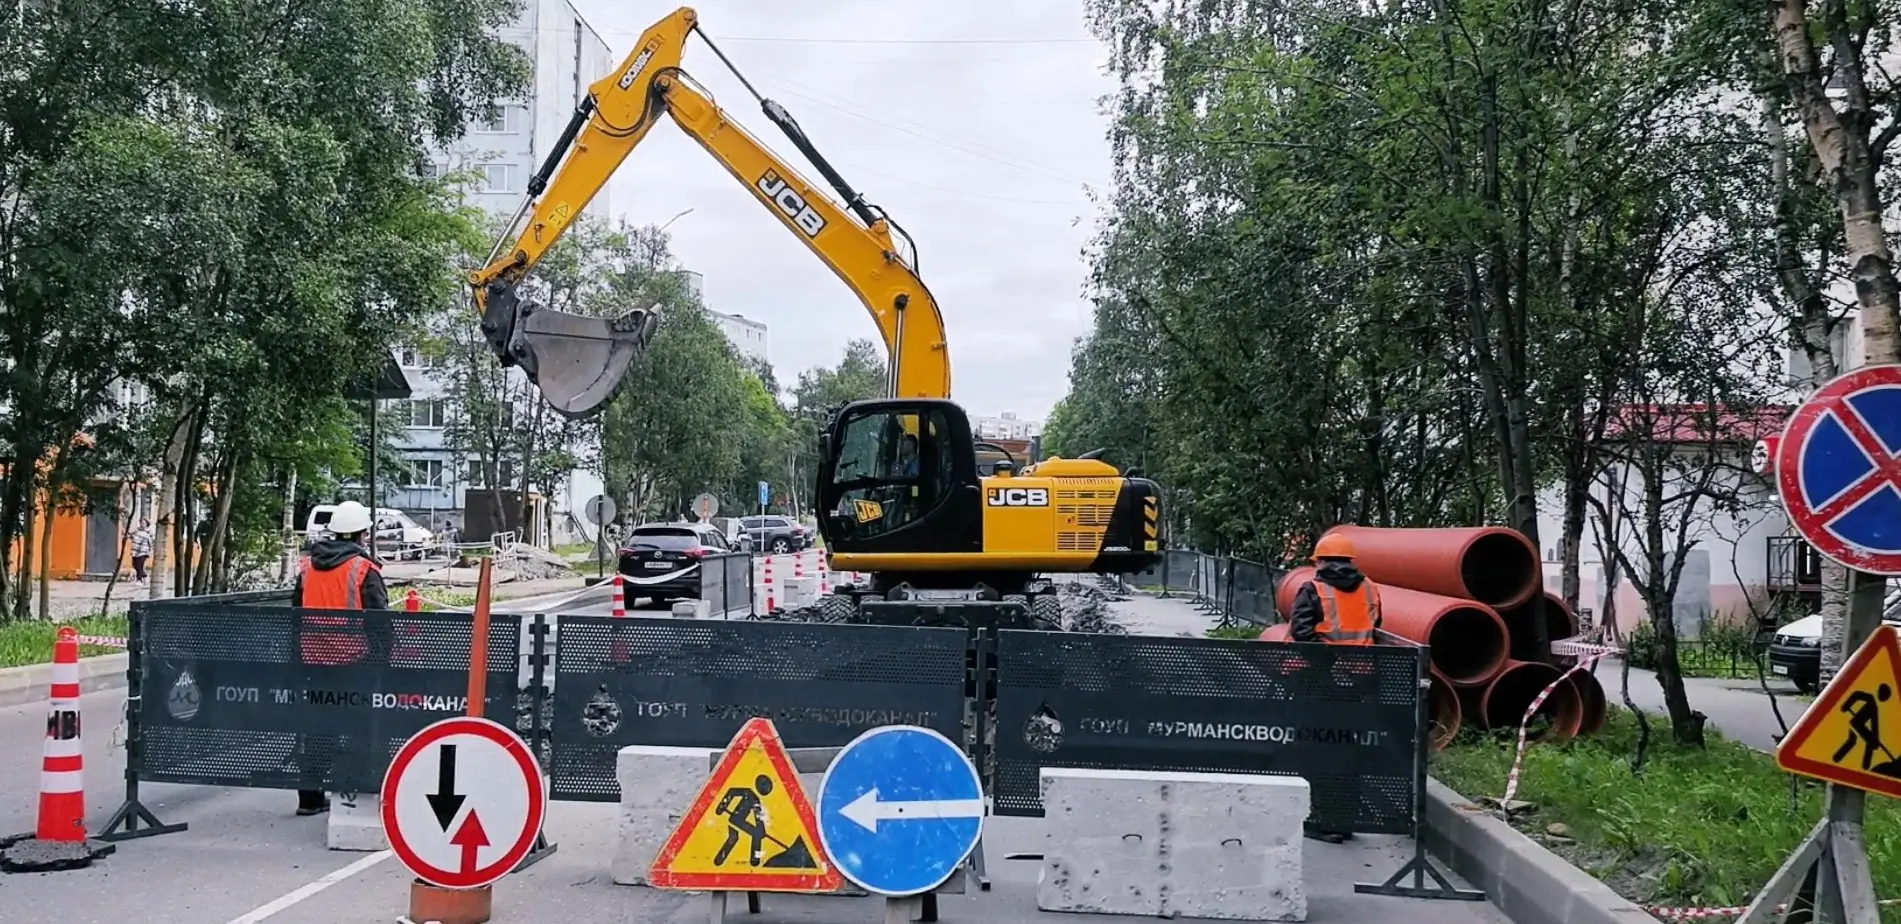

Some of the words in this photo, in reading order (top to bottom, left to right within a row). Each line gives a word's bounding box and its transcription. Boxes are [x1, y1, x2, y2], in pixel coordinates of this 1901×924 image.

[758, 177, 825, 236] JCB
[988, 489, 1048, 506] JCB
[215, 685, 259, 703] ГОУП
